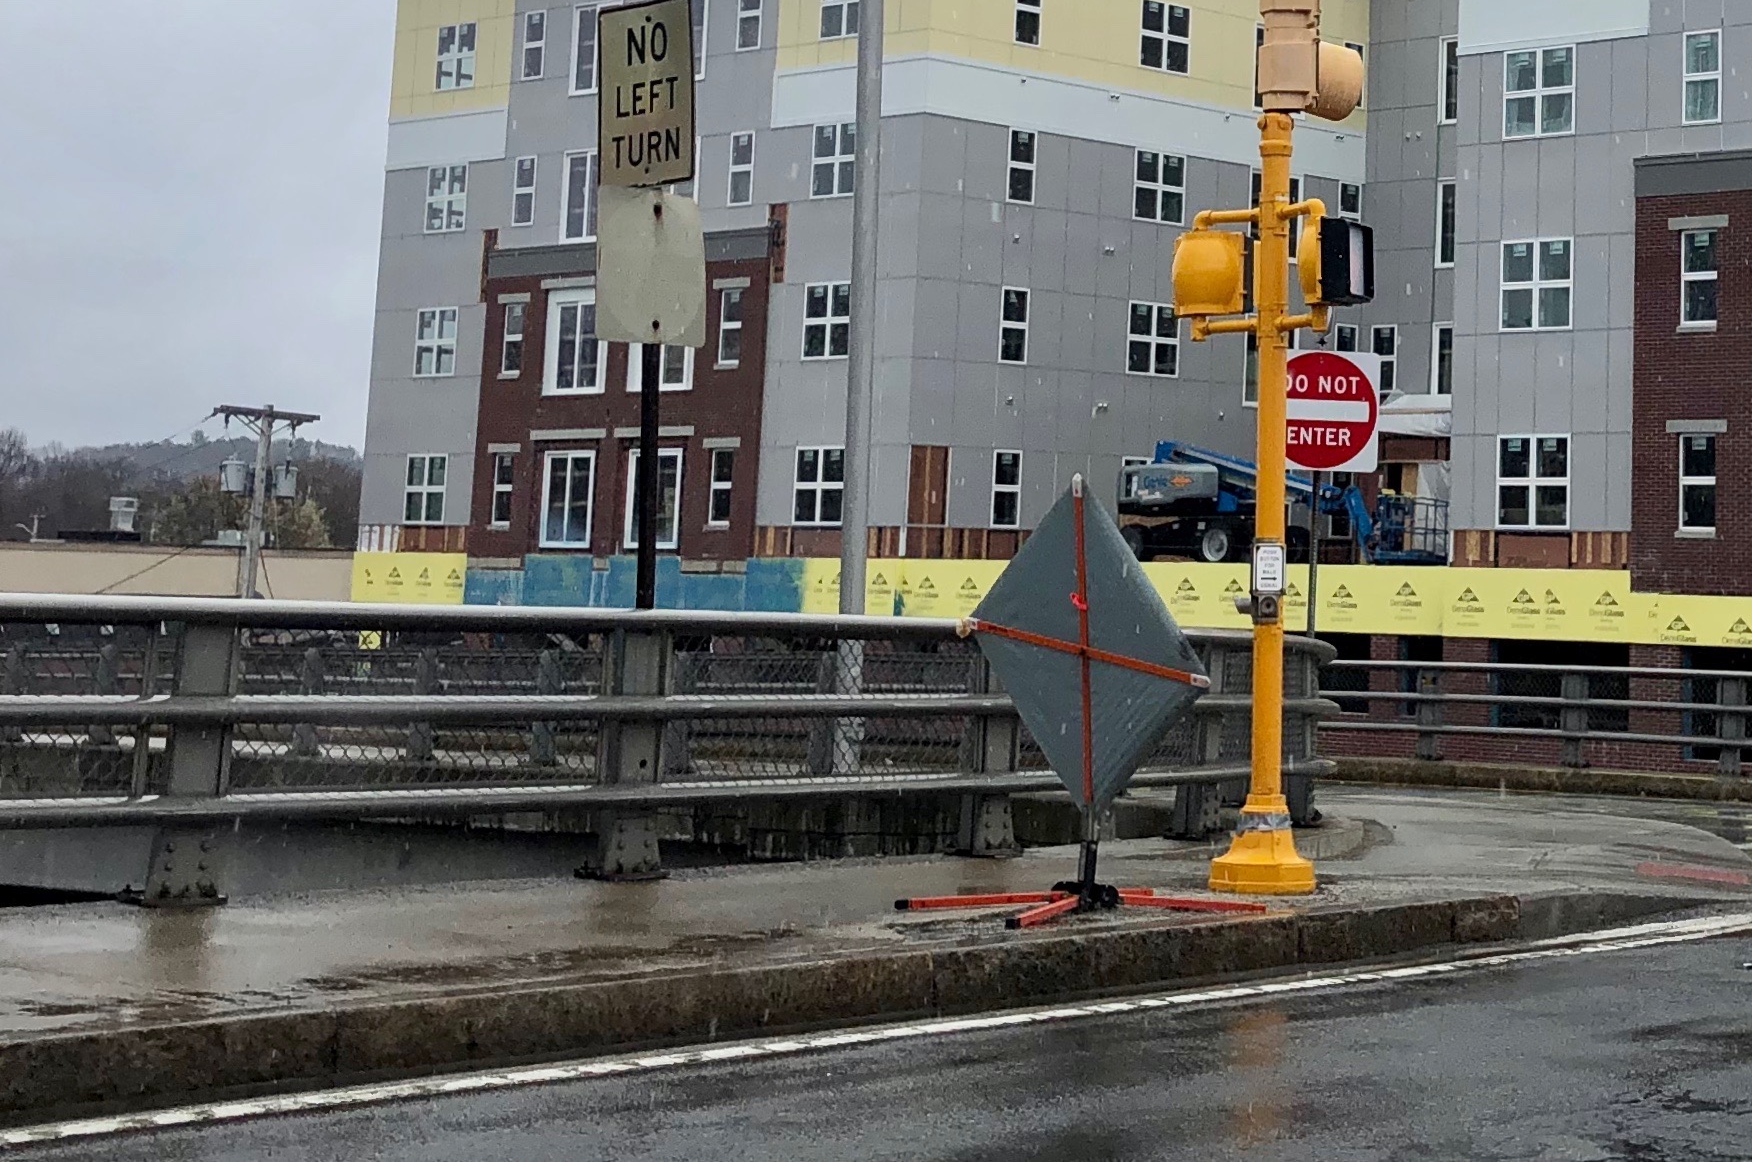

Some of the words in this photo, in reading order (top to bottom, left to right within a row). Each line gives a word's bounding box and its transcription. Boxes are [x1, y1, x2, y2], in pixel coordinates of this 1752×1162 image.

[627, 22, 668, 66] NO
[616, 76, 678, 118] LEFT
[612, 126, 680, 169] TURN
[1318, 375, 1360, 394] NOT
[1287, 427, 1351, 446] ENTER
